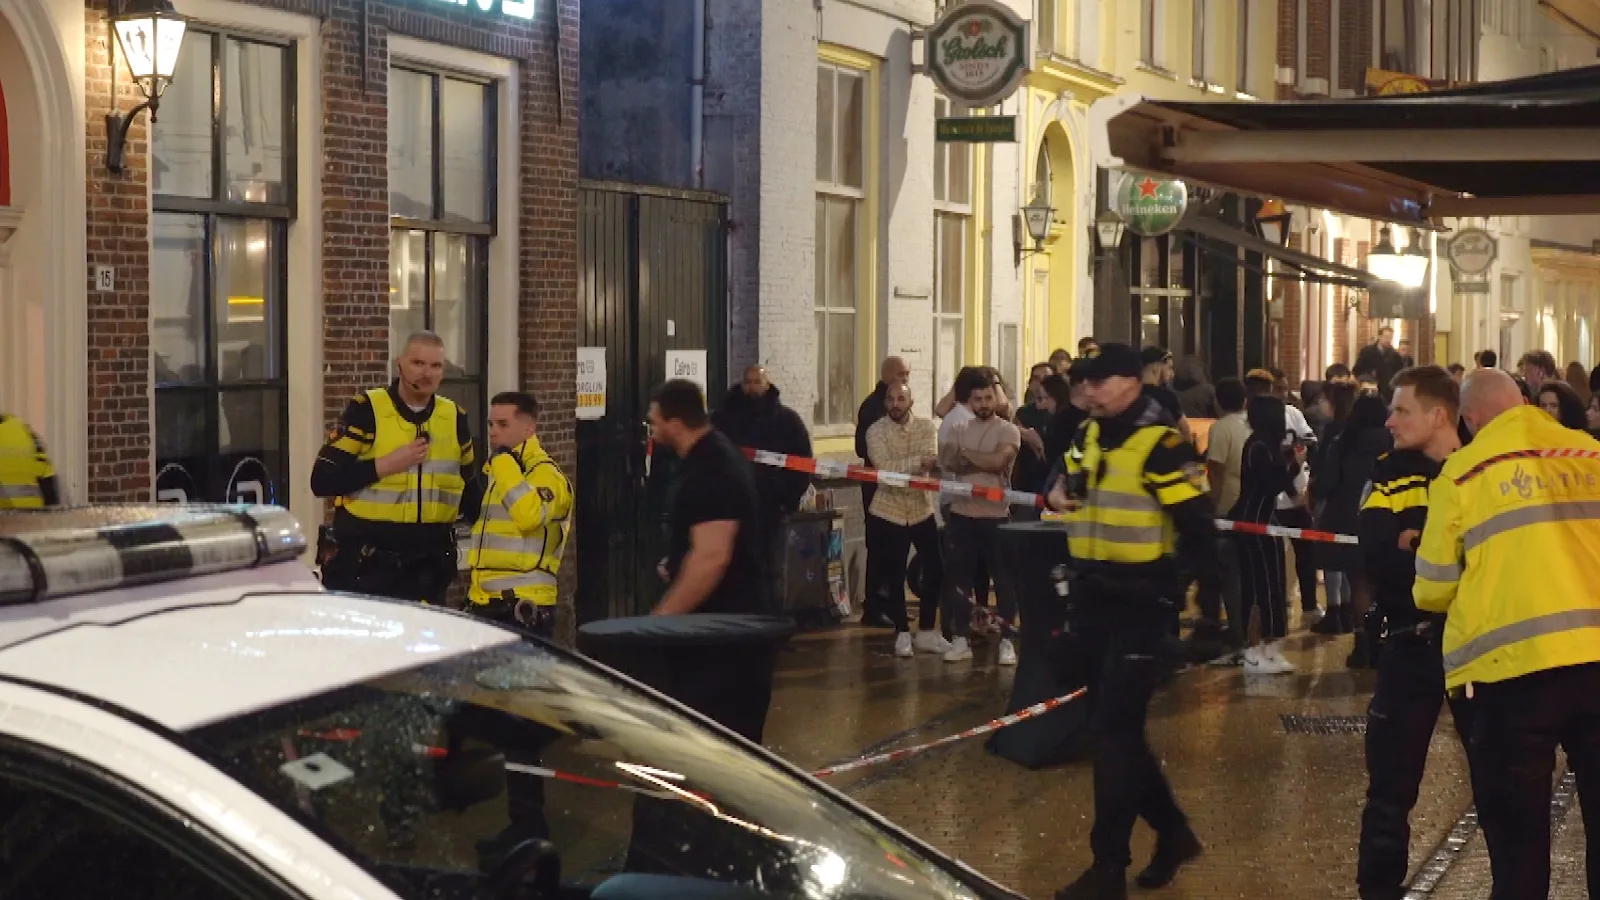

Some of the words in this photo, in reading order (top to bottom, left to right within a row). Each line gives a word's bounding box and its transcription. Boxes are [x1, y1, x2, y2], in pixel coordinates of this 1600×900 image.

[942, 36, 1006, 66] Grolsch
[1122, 203, 1178, 215] Heineken
[101, 270, 111, 287] 15
